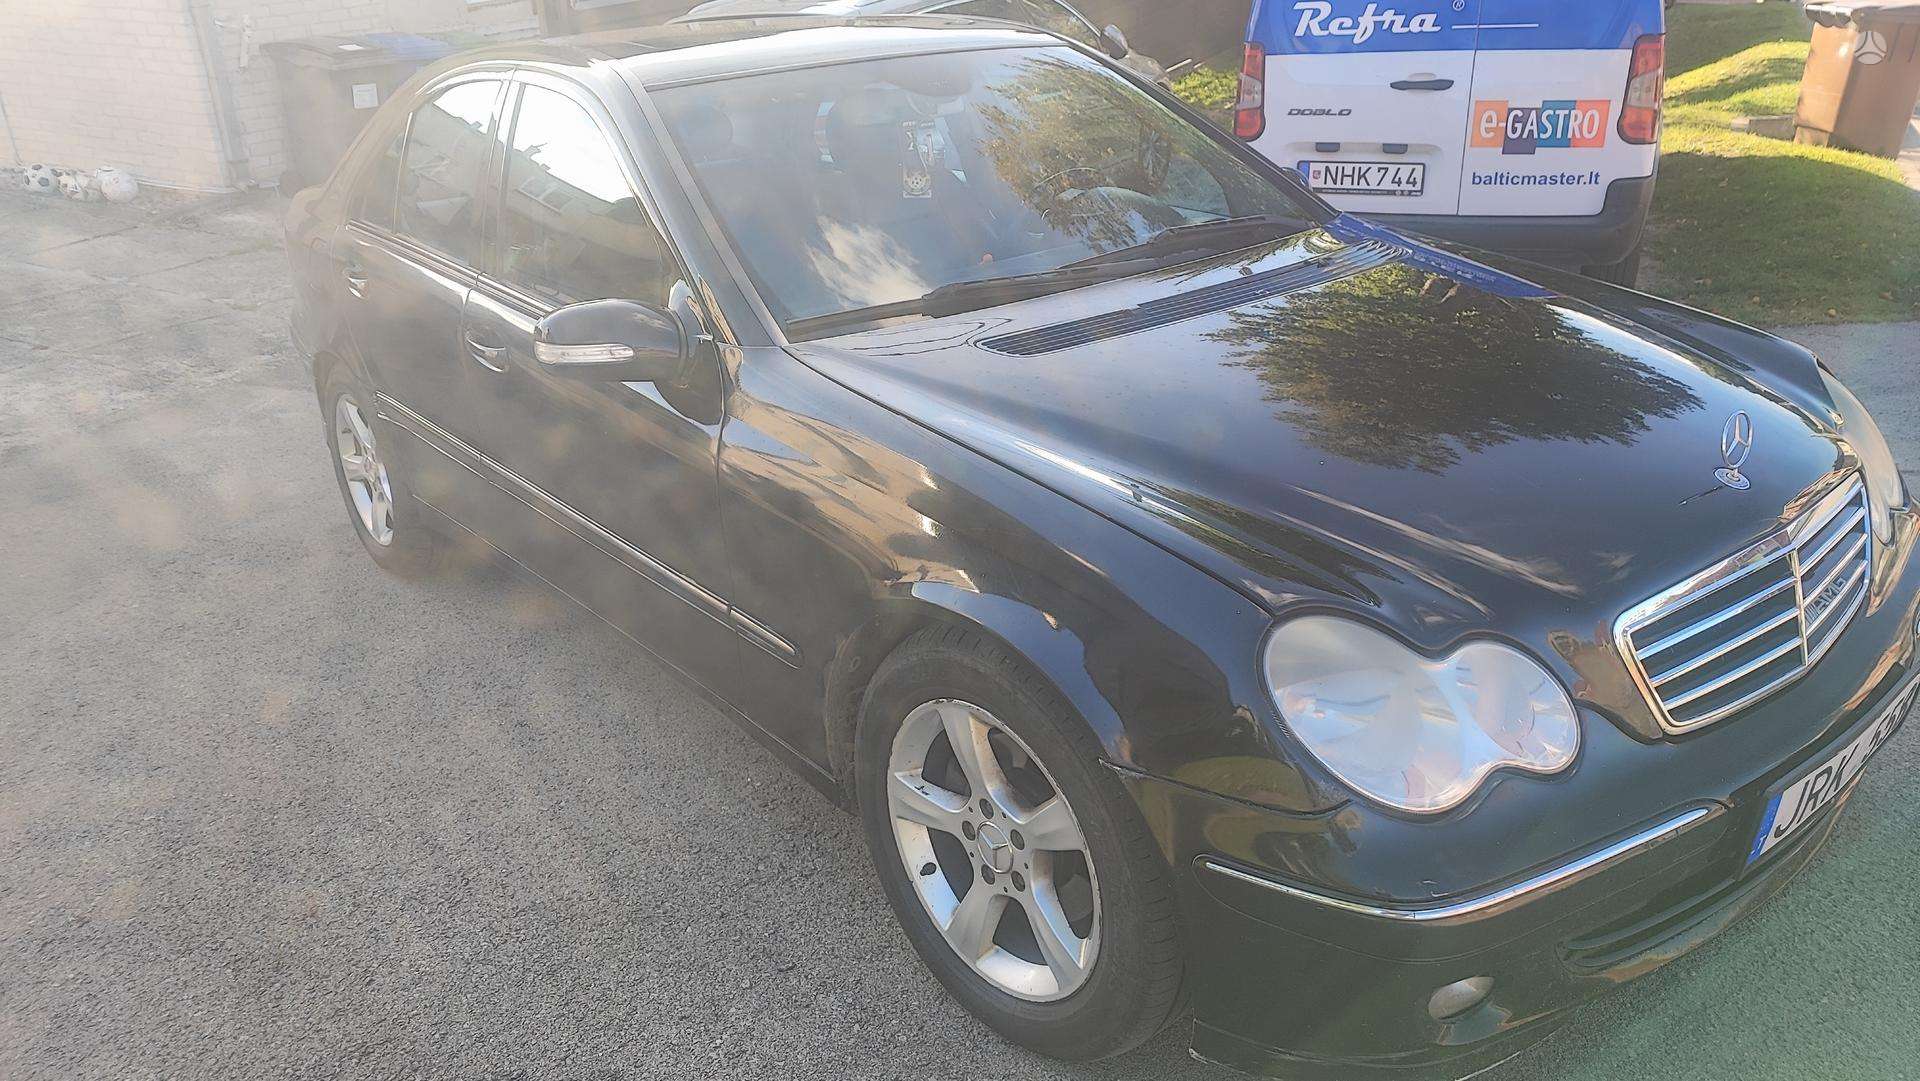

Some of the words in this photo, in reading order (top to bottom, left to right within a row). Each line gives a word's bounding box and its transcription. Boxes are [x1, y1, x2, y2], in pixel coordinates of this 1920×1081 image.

[1293, 1, 1442, 45] Refra
[1288, 108, 1352, 116] DOBLO
[1480, 109, 1600, 139] e-GASTRO
[1323, 165, 1372, 187] NHK
[1376, 166, 1418, 188] 744
[1471, 171, 1600, 186] balticmaster.lt
[1808, 577, 1847, 615] AMG
[1773, 743, 1859, 839] JRK
